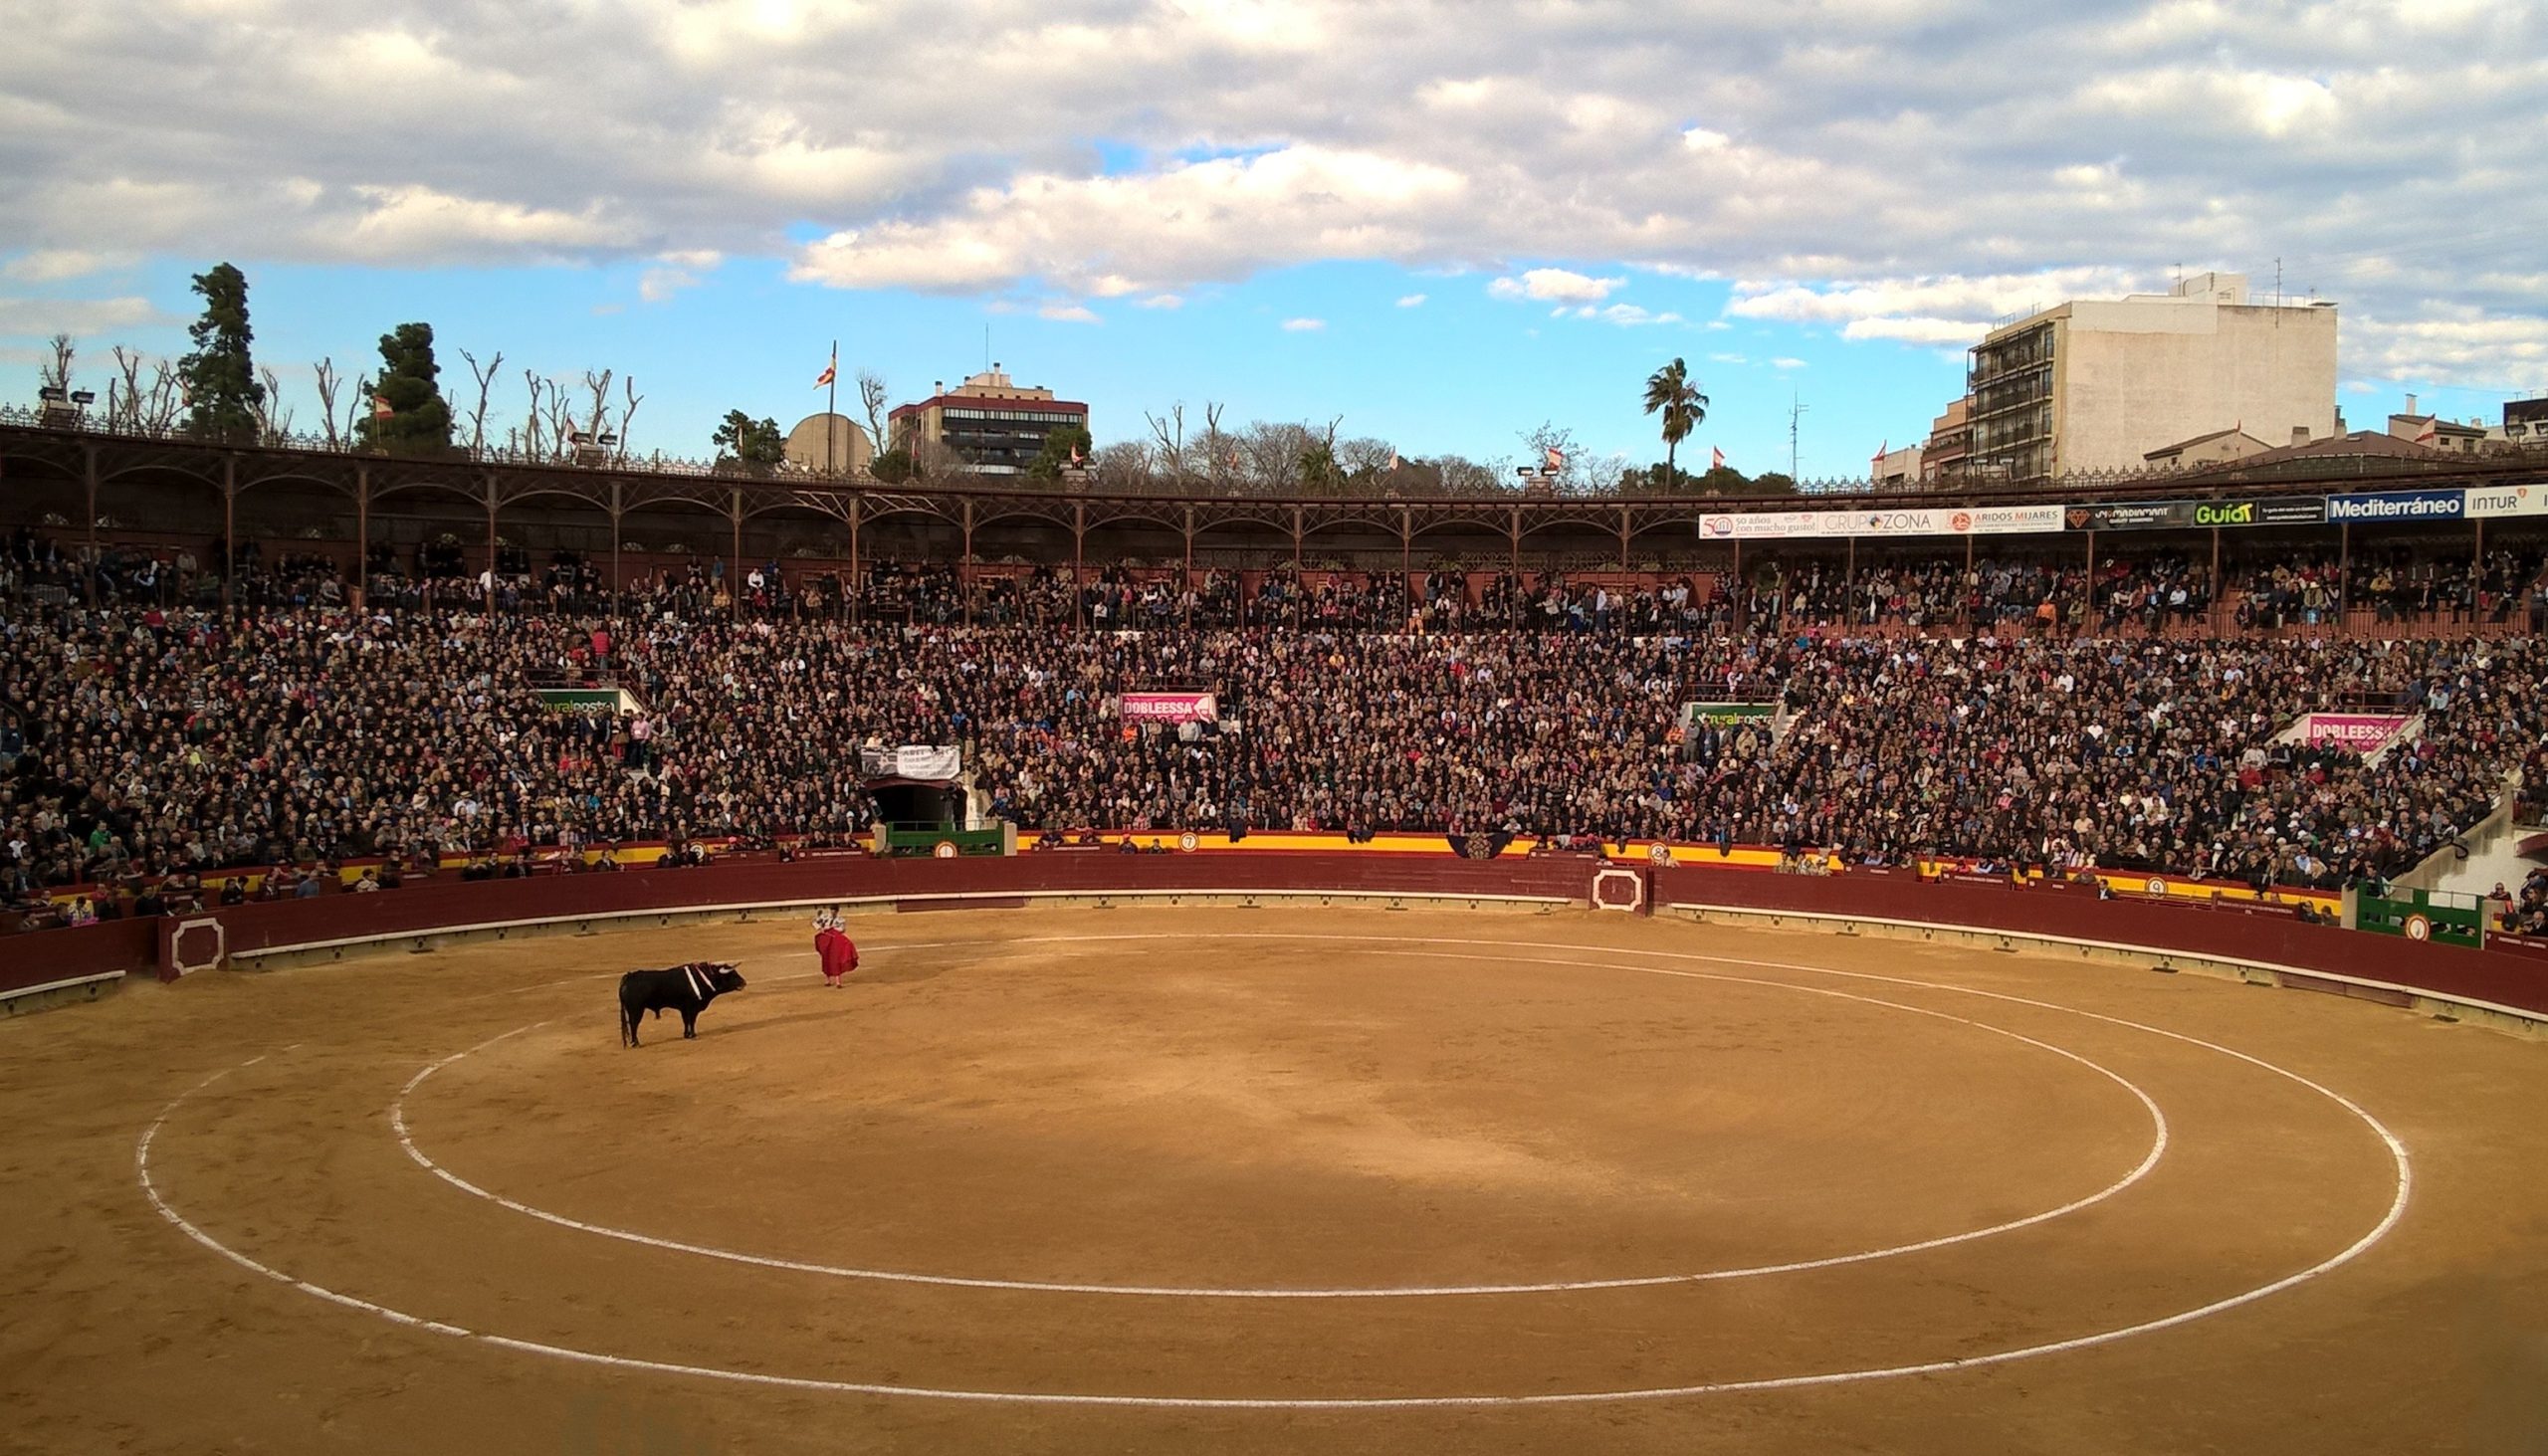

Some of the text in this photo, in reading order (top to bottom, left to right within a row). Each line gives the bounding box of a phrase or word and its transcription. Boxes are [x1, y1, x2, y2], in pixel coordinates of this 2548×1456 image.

[2332, 497, 2460, 518] Mediterráneo
[2472, 496, 2517, 510] INTUR
[1749, 516, 1771, 524] años
[1975, 511, 2058, 522] ARIDOS MIJARES
[1754, 522, 1787, 532] mucho
[1788, 522, 1815, 533] gusto!
[1124, 702, 1193, 714] DOBLEESSA
[1185, 836, 1192, 847] 7
